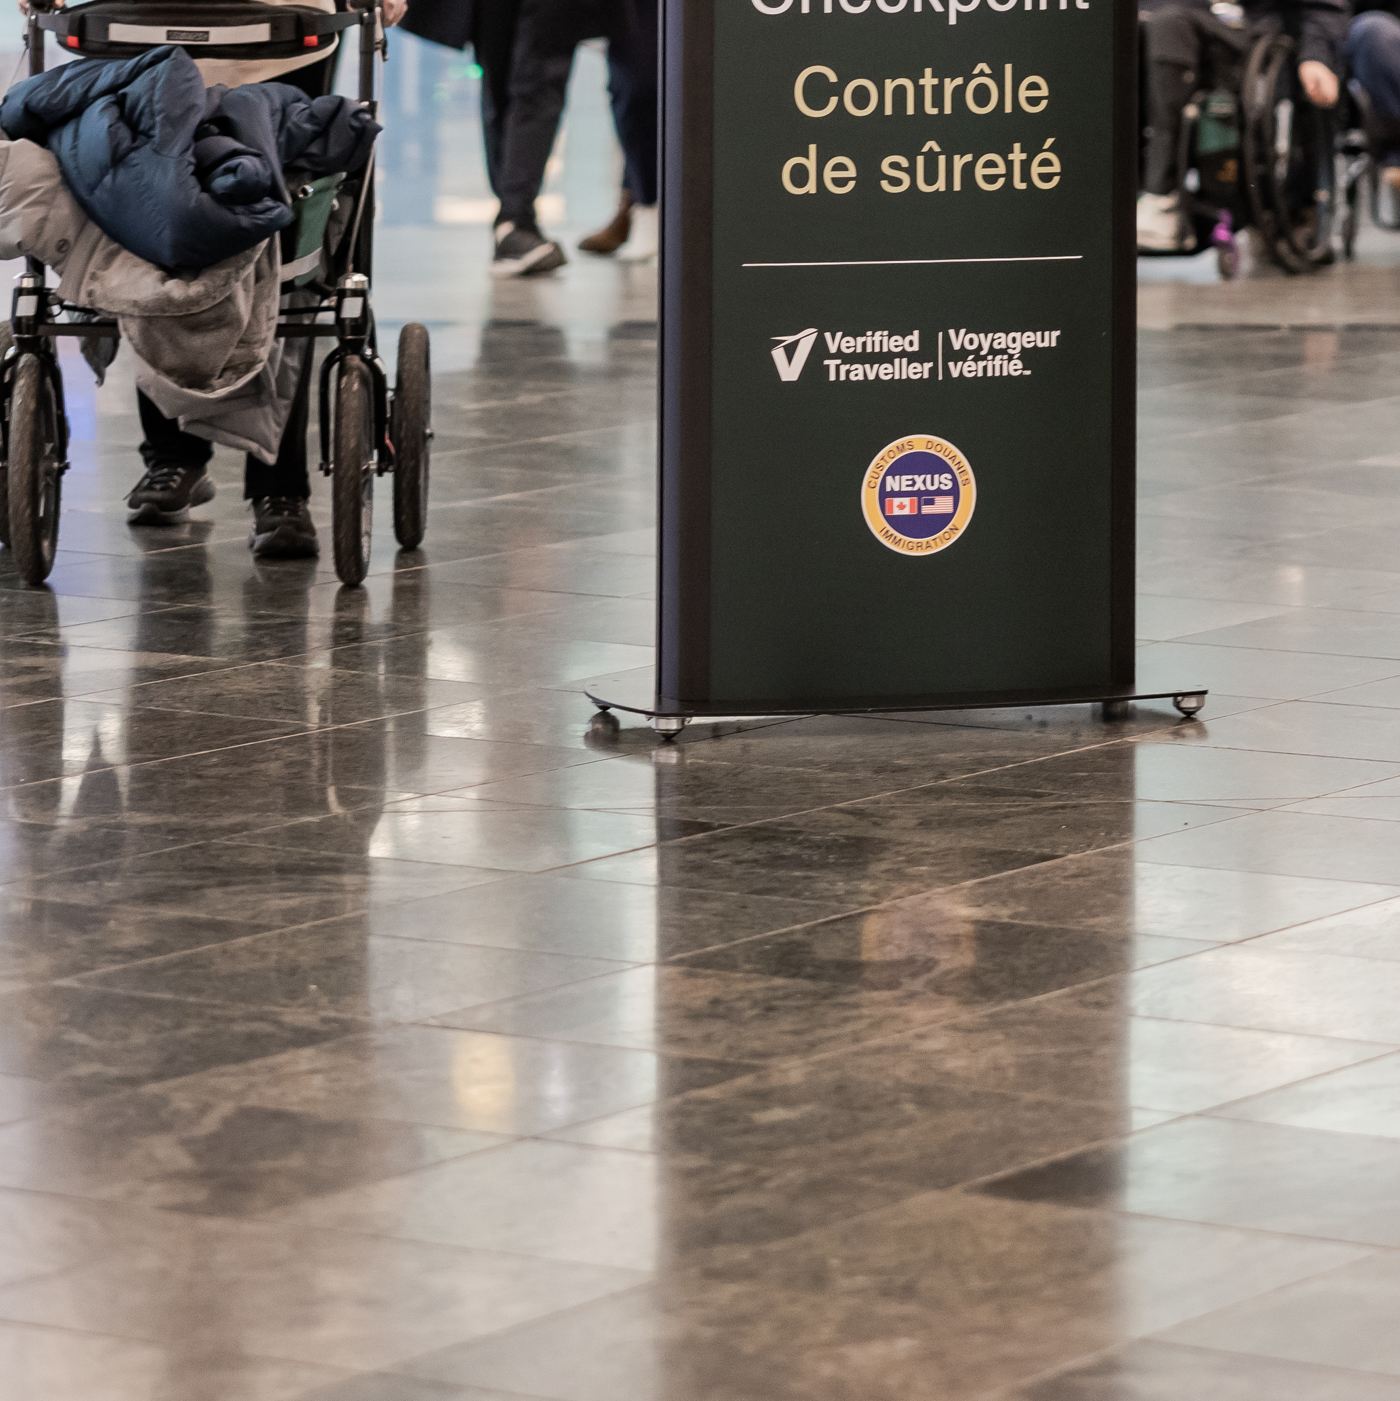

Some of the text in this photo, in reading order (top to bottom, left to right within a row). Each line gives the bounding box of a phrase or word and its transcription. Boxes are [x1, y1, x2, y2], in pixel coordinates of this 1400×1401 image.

[793, 62, 1050, 118] Contrôle
[781, 137, 1062, 195] de sûreté
[823, 329, 920, 354] Verified
[947, 328, 1061, 356] Voyageur
[823, 357, 934, 382] Traveller
[867, 440, 915, 489] CUSTOMS
[925, 440, 971, 487] DOUANES
[885, 473, 953, 492] NEXUS
[879, 523, 960, 552] IMMIGRATION
